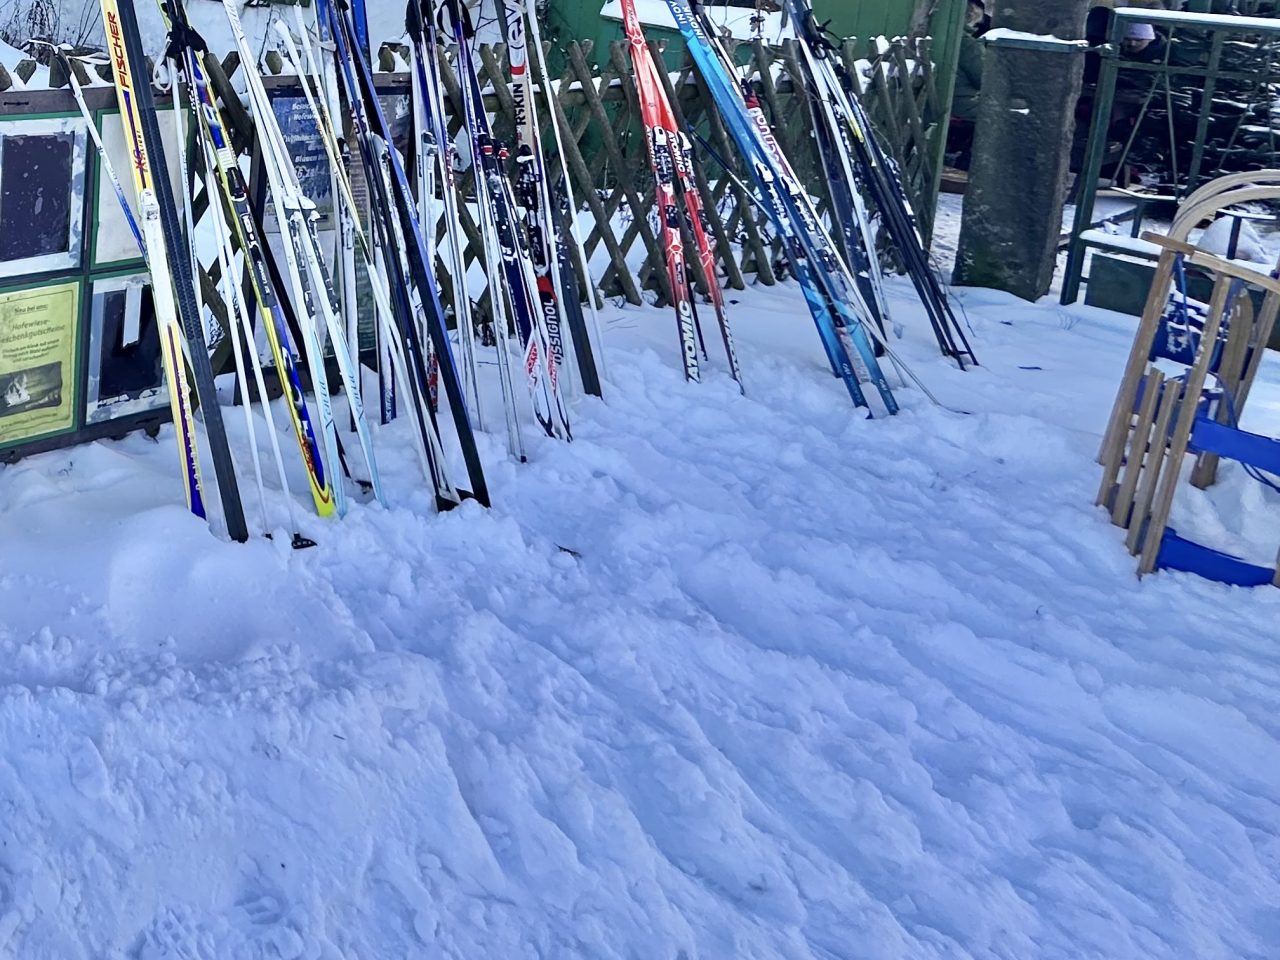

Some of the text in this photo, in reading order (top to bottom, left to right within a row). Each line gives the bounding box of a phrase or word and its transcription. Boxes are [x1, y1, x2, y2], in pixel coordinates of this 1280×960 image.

[107, 12, 130, 88] FISCHER
[682, 6, 706, 39] INOVIK
[679, 299, 701, 384] ATOMIC
